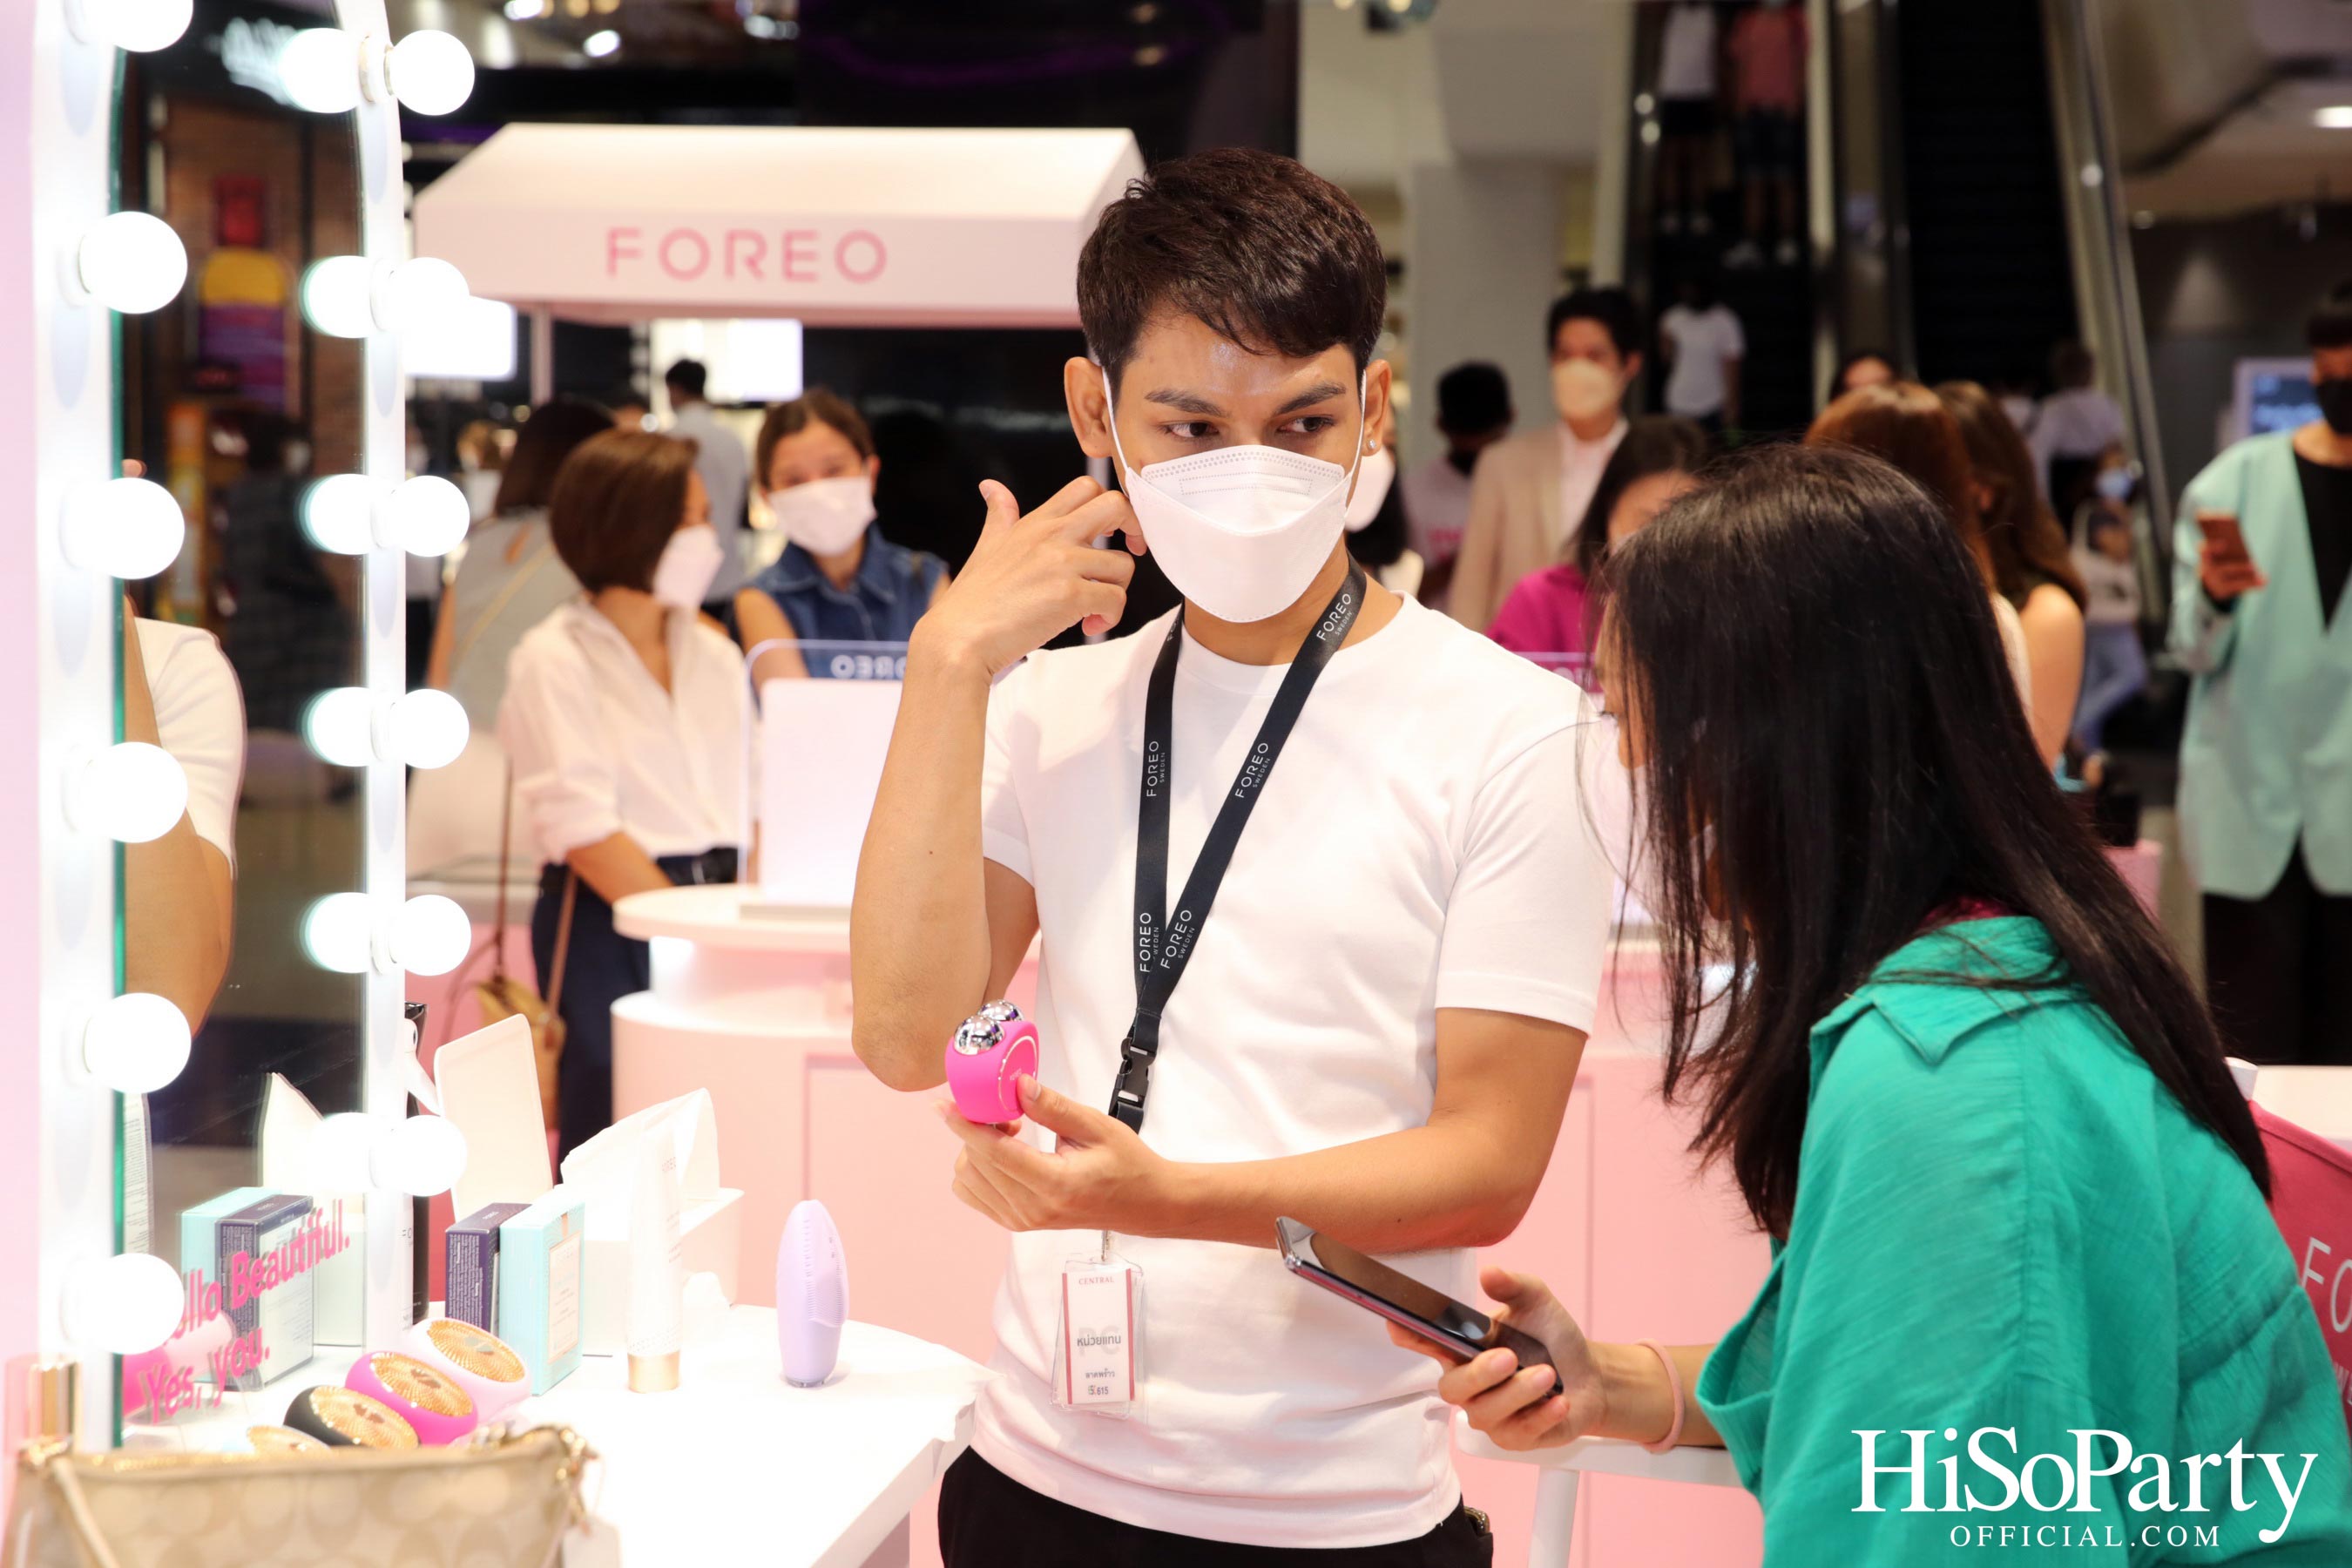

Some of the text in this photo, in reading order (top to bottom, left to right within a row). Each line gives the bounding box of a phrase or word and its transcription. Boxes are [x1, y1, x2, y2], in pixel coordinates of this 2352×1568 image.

[605, 227, 888, 284] FOREO
[1316, 593, 1351, 640] FOREO
[1335, 612, 1354, 636] SWEDEN
[1146, 740, 1159, 797] FOREO
[1234, 742, 1269, 799] FOREO
[1253, 758, 1271, 788] SWEDEN
[1139, 912, 1152, 973] FOREO
[1160, 909, 1193, 970] FOREO
[1178, 927, 1195, 959] SWEDEN
[231, 1199, 350, 1310] Beautiful.
[1078, 1276, 1115, 1286] CENTRAL
[1077, 1334, 1122, 1348] หน่วยแทน
[146, 1327, 271, 1424] Yes, you.
